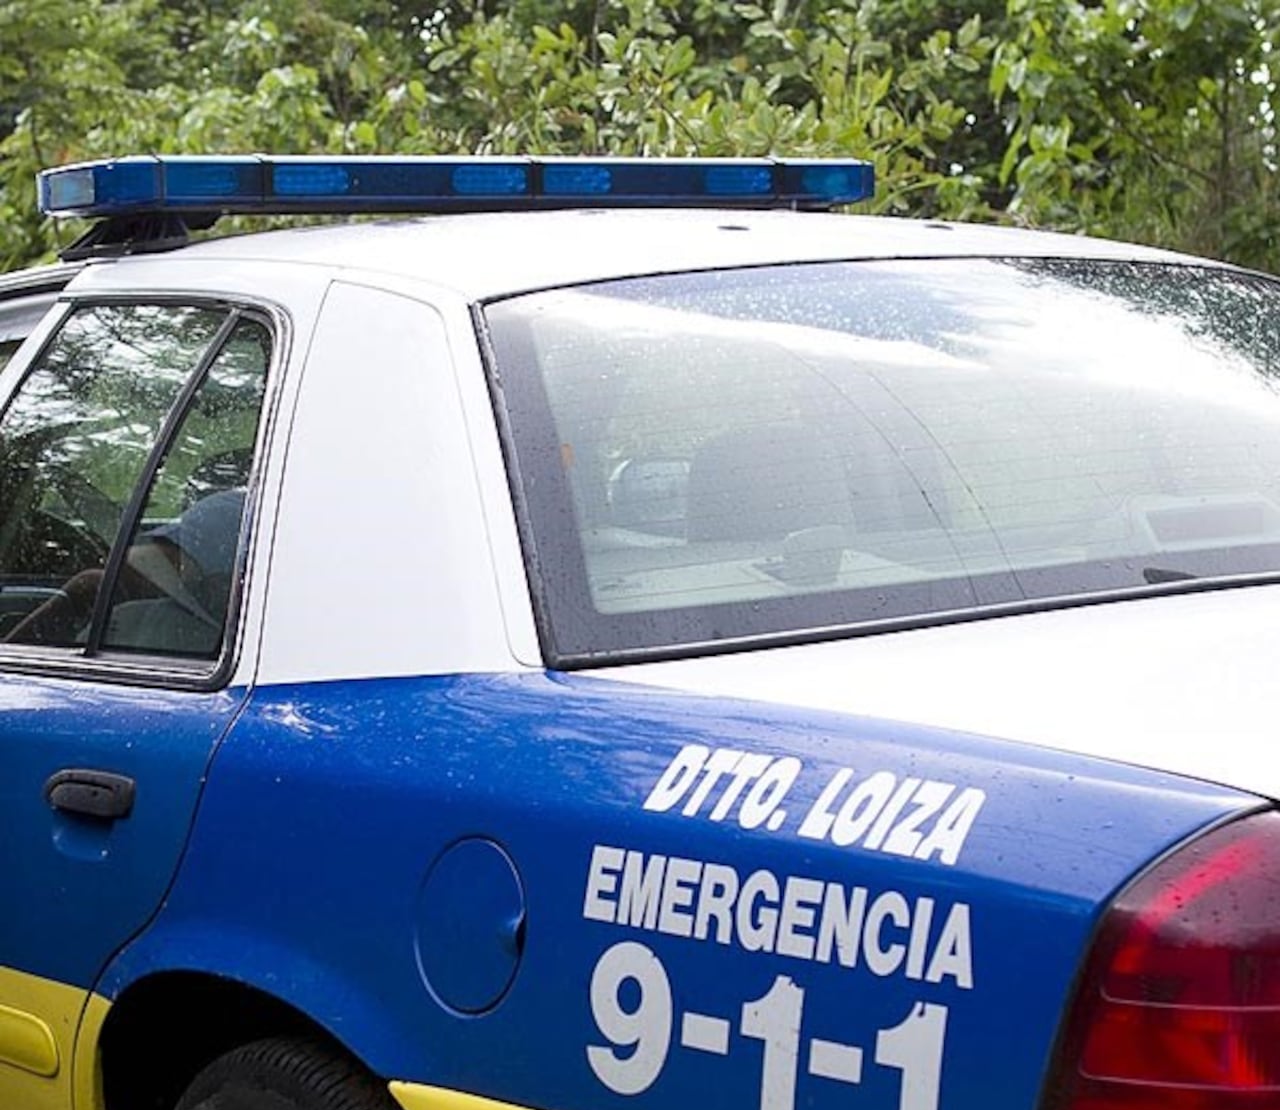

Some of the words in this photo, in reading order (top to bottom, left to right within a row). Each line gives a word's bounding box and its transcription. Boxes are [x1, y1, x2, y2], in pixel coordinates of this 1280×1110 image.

[643, 744, 802, 831] DTTO.
[797, 767, 986, 865] LOIZA
[583, 845, 974, 989] EMERGENCIA
